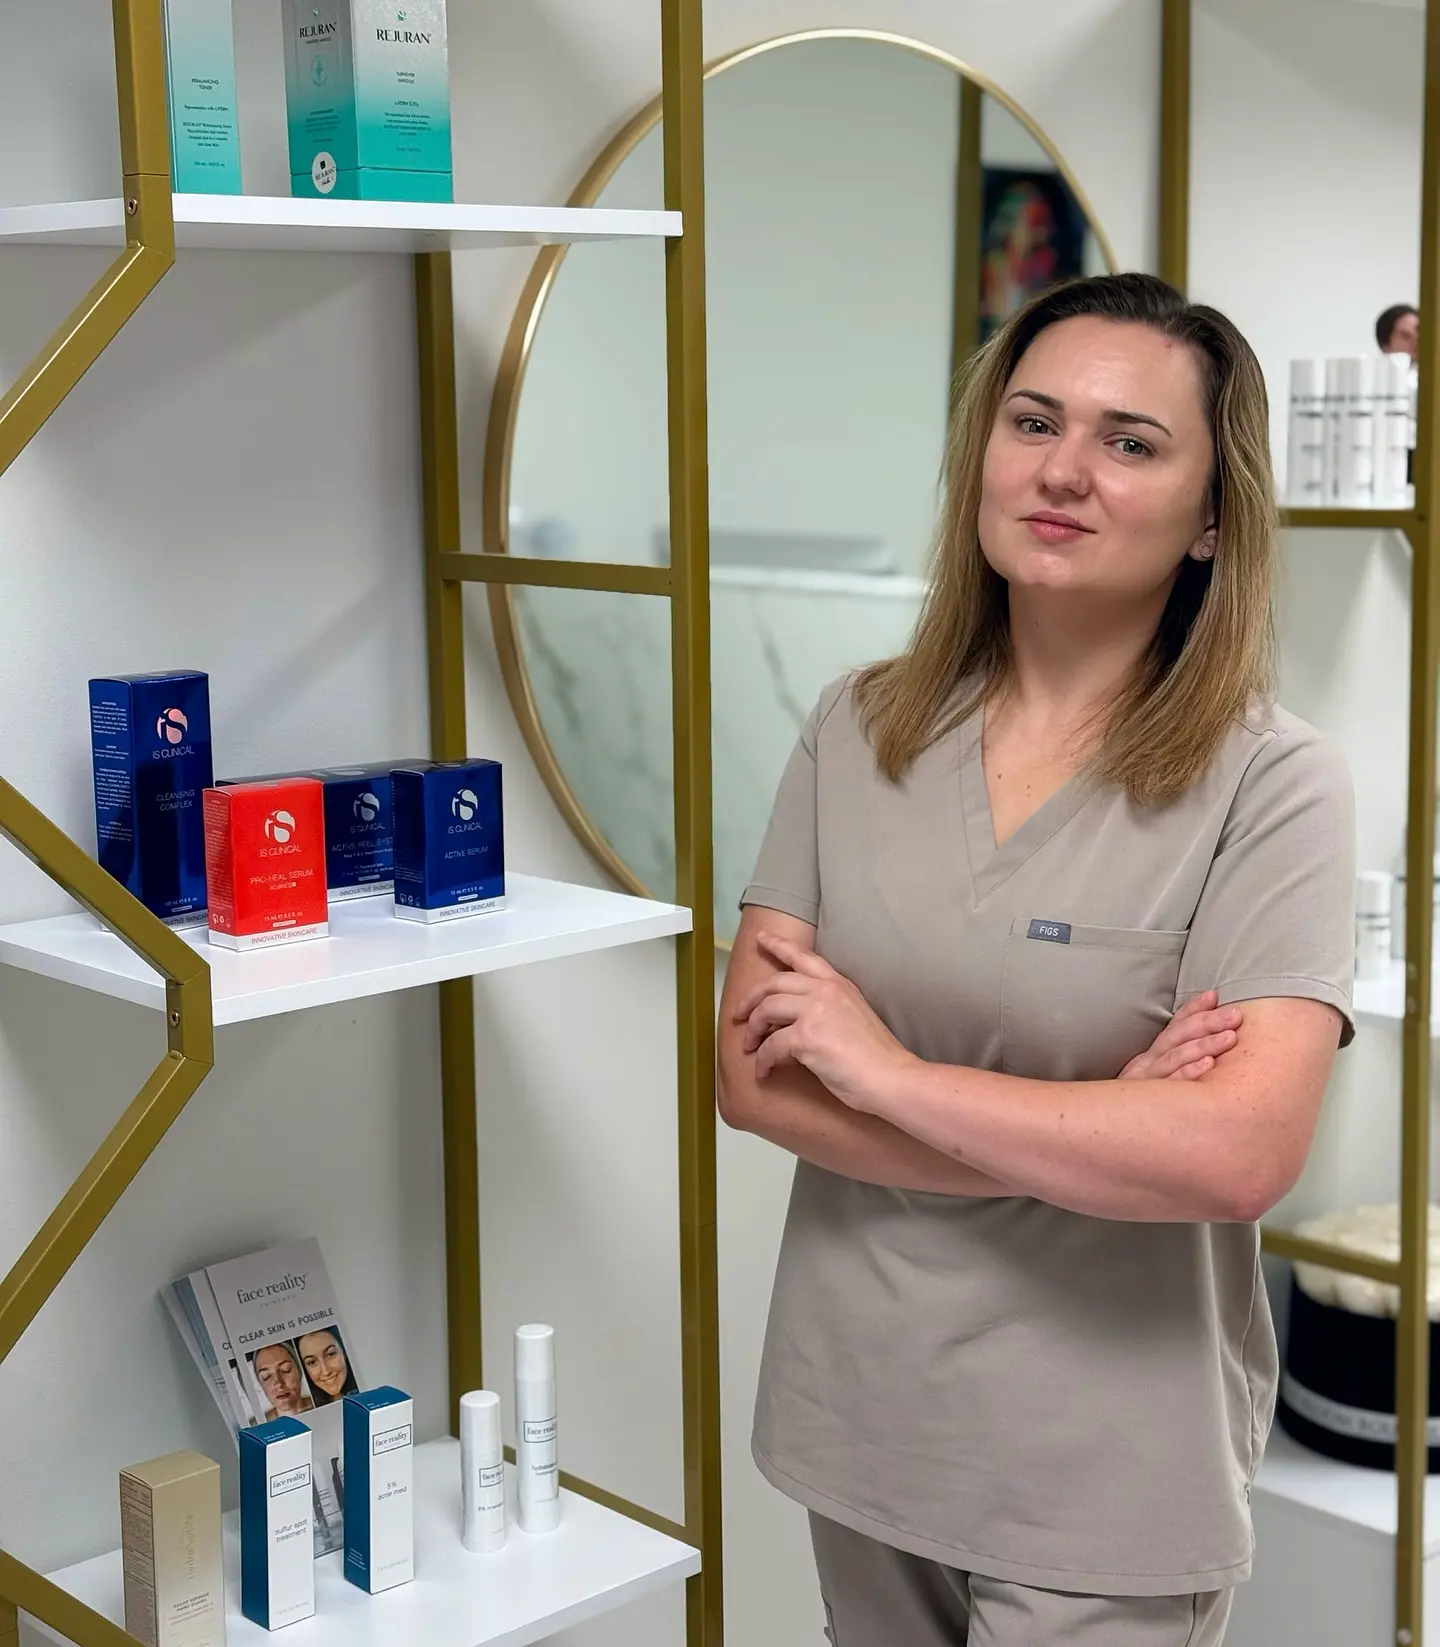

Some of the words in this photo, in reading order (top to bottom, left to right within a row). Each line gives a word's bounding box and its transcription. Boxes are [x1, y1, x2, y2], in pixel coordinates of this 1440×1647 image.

[300, 23, 336, 38] REJURAN
[376, 28, 430, 44] REJURAN
[161, 746, 195, 758] CLINICAL
[156, 790, 195, 802] CLEANSING
[160, 800, 193, 812] COMPLEX
[455, 822, 484, 833] CLINICAL
[268, 845, 302, 856] CLINICAL
[332, 843, 356, 852] ACTIVE
[444, 850, 465, 859] ACTIVE
[466, 846, 488, 856] SERUM
[250, 873, 287, 884] PRO-HEAL
[288, 869, 314, 879] SERUM
[340, 886, 372, 896] INNOVATIVE
[440, 906, 470, 917] INNOVATIVE
[471, 901, 496, 912] SKINCARE
[252, 932, 287, 944] INNOVATIVE
[288, 927, 318, 938] SKINCARE
[1040, 926, 1059, 936] FIGS
[237, 1289, 264, 1304] face
[266, 1272, 306, 1295] reality
[238, 1330, 265, 1344] CLEAR
[267, 1323, 286, 1335] SKIN
[288, 1320, 295, 1328] IS
[298, 1308, 334, 1325] POSSIBLE
[375, 1438, 388, 1447] face
[388, 1432, 408, 1443] reality
[272, 1480, 286, 1489] face
[287, 1472, 306, 1484] reality
[378, 1490, 392, 1500] acne
[393, 1486, 407, 1496] med
[275, 1523, 292, 1536] sulfur
[293, 1519, 307, 1529] spot
[276, 1527, 307, 1543] treatment
